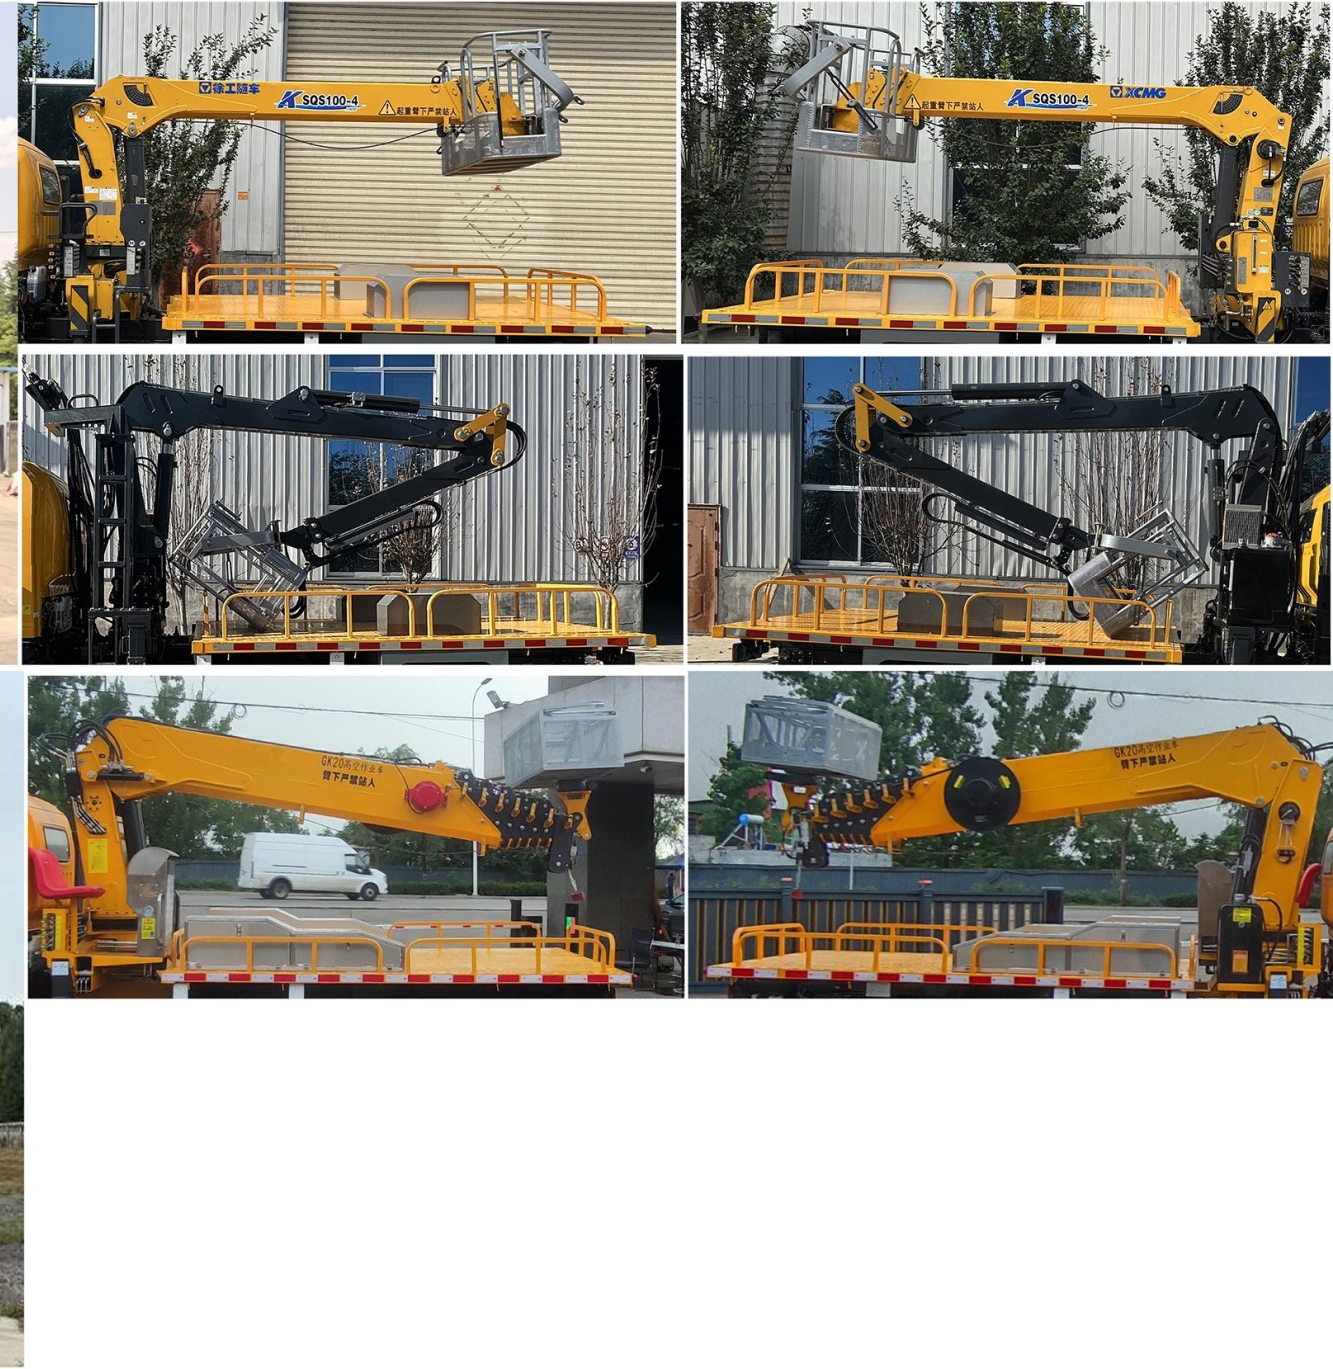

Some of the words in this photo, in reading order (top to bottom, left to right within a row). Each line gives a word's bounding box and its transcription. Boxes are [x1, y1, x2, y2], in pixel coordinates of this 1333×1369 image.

[213, 82, 261, 94] 徐工随车
[1124, 87, 1167, 99] XCMG
[302, 94, 359, 106] SQS100-4
[1033, 93, 1090, 105] SQS100-4
[396, 106, 457, 116] 起重臂下严禁站人
[921, 101, 984, 111] 起重臂下严禁站人
